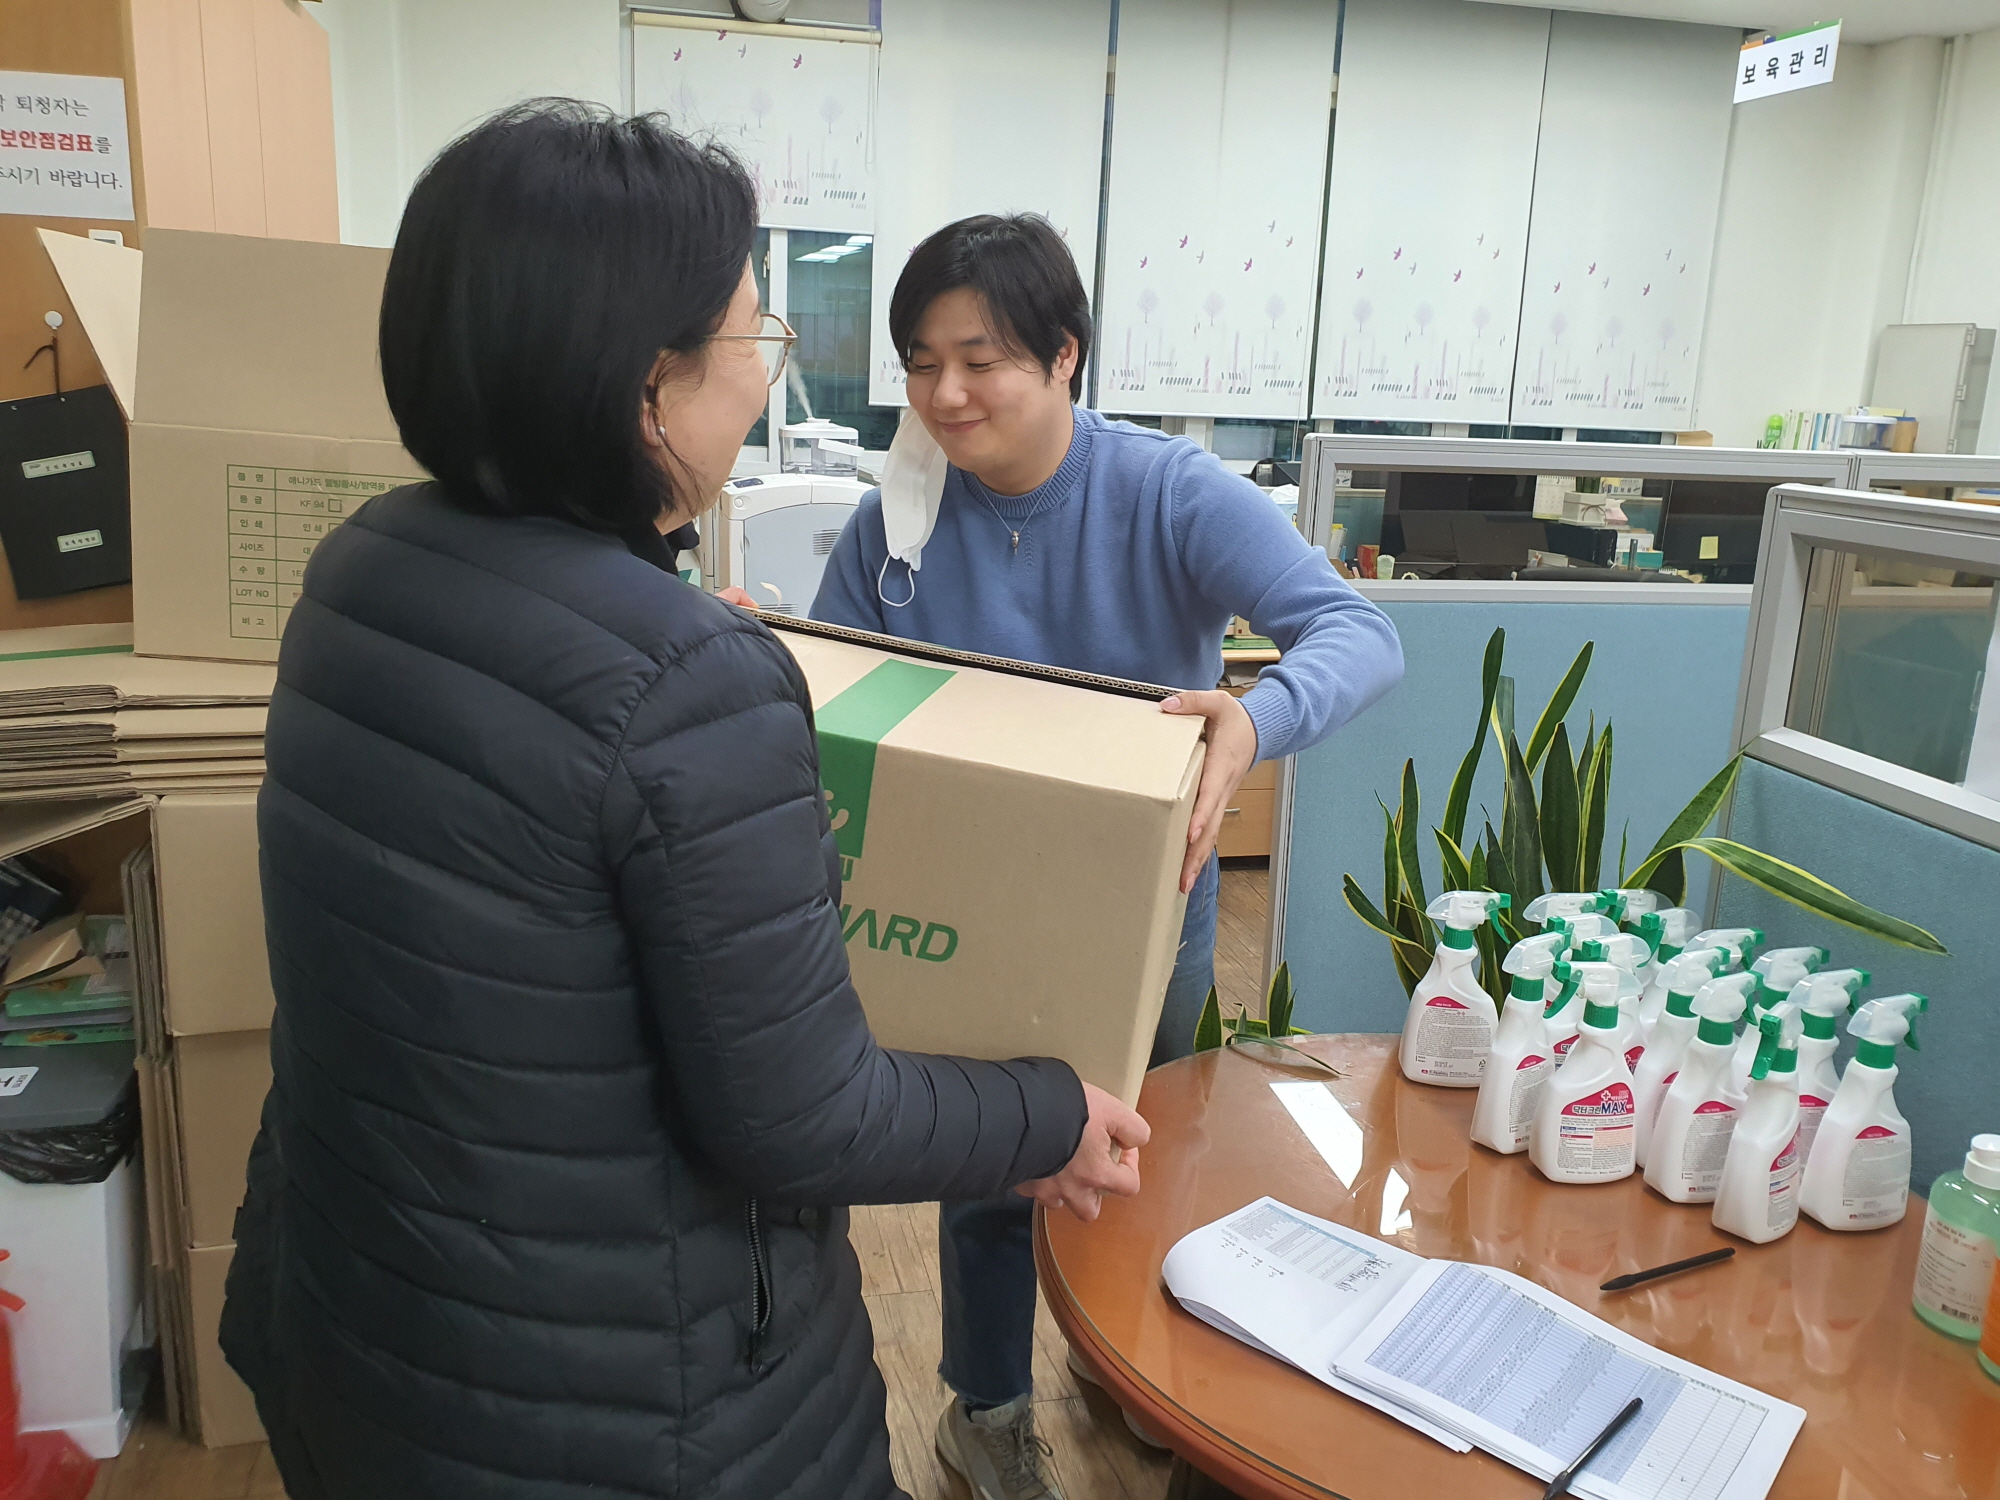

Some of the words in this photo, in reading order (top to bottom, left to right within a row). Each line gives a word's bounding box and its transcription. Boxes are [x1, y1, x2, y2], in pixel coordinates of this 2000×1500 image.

[17, 95, 89, 117] 퇴청자는
[0, 129, 112, 154] 보안점검표를
[48, 168, 122, 190] 바랍니다.
[288, 476, 322, 486] 애니가드
[300, 499, 311, 508] KF
[313, 501, 325, 509] 94
[239, 542, 265, 552] 사이즈
[235, 588, 253, 597] LOT
[255, 589, 270, 598] NO
